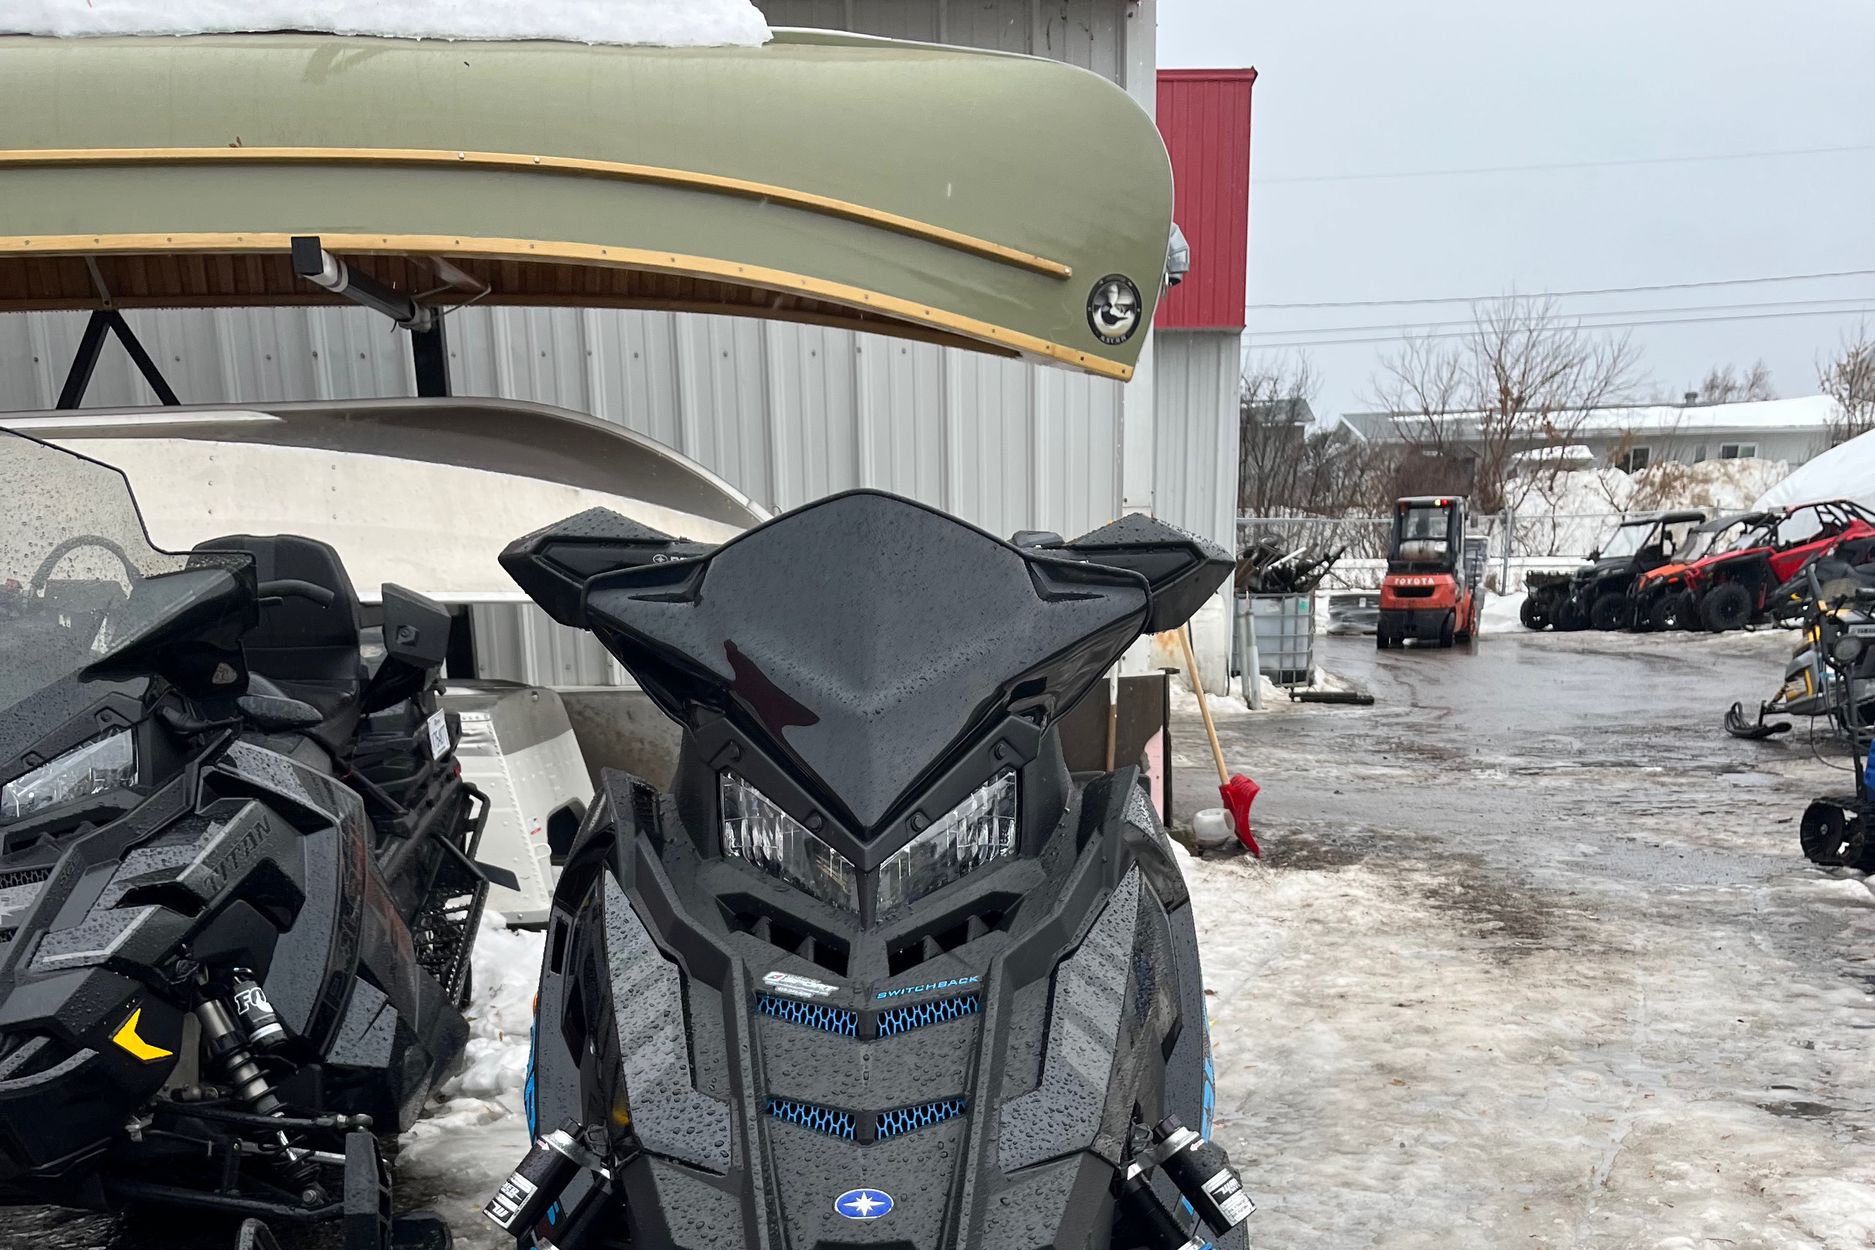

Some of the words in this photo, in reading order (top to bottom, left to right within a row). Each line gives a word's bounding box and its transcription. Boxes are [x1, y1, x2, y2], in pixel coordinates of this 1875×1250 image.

[1395, 577, 1434, 585] TOYOTA
[203, 814, 272, 892] TITAN
[877, 976, 979, 999] SWITCHBACK
